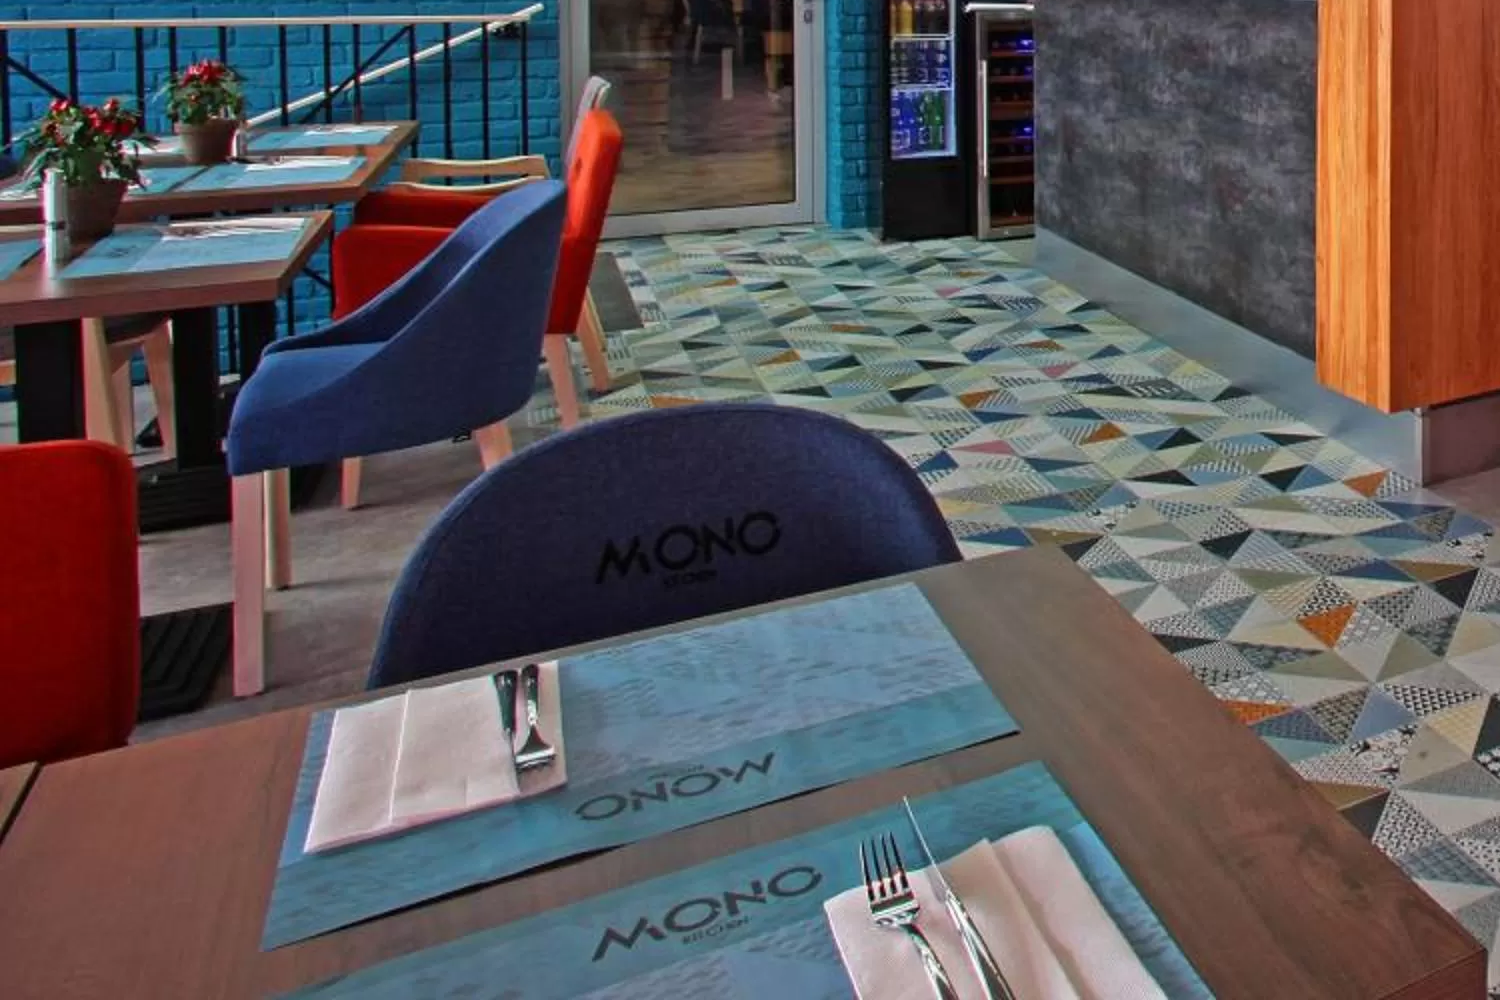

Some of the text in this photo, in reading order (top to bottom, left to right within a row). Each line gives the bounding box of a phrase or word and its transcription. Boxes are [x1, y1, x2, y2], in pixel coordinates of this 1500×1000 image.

[595, 511, 781, 584] MONO
[575, 752, 775, 821] MONO
[592, 866, 823, 962] MONO
